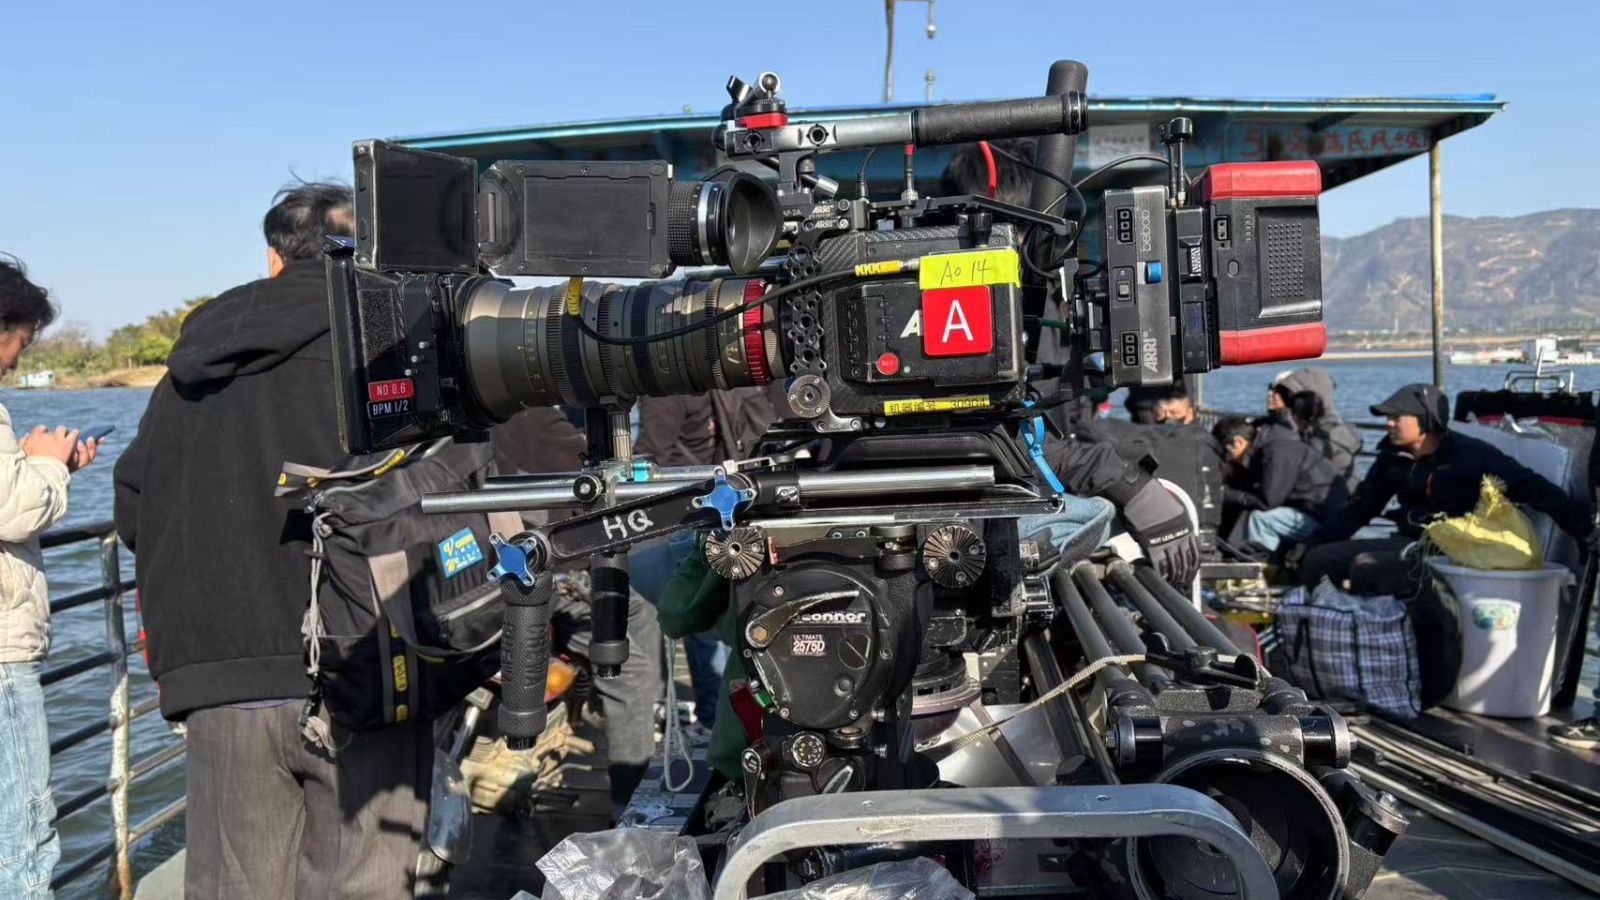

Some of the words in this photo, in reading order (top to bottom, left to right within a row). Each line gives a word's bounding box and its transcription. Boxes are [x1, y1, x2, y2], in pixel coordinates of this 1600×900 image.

[941, 299, 974, 344] A
[1142, 337, 1159, 373] ARRI
[372, 403, 392, 416] BPM
[394, 399, 409, 413] 1/2
[602, 509, 655, 540] HQ
[798, 611, 866, 624] connor
[793, 640, 826, 653] 2575D
